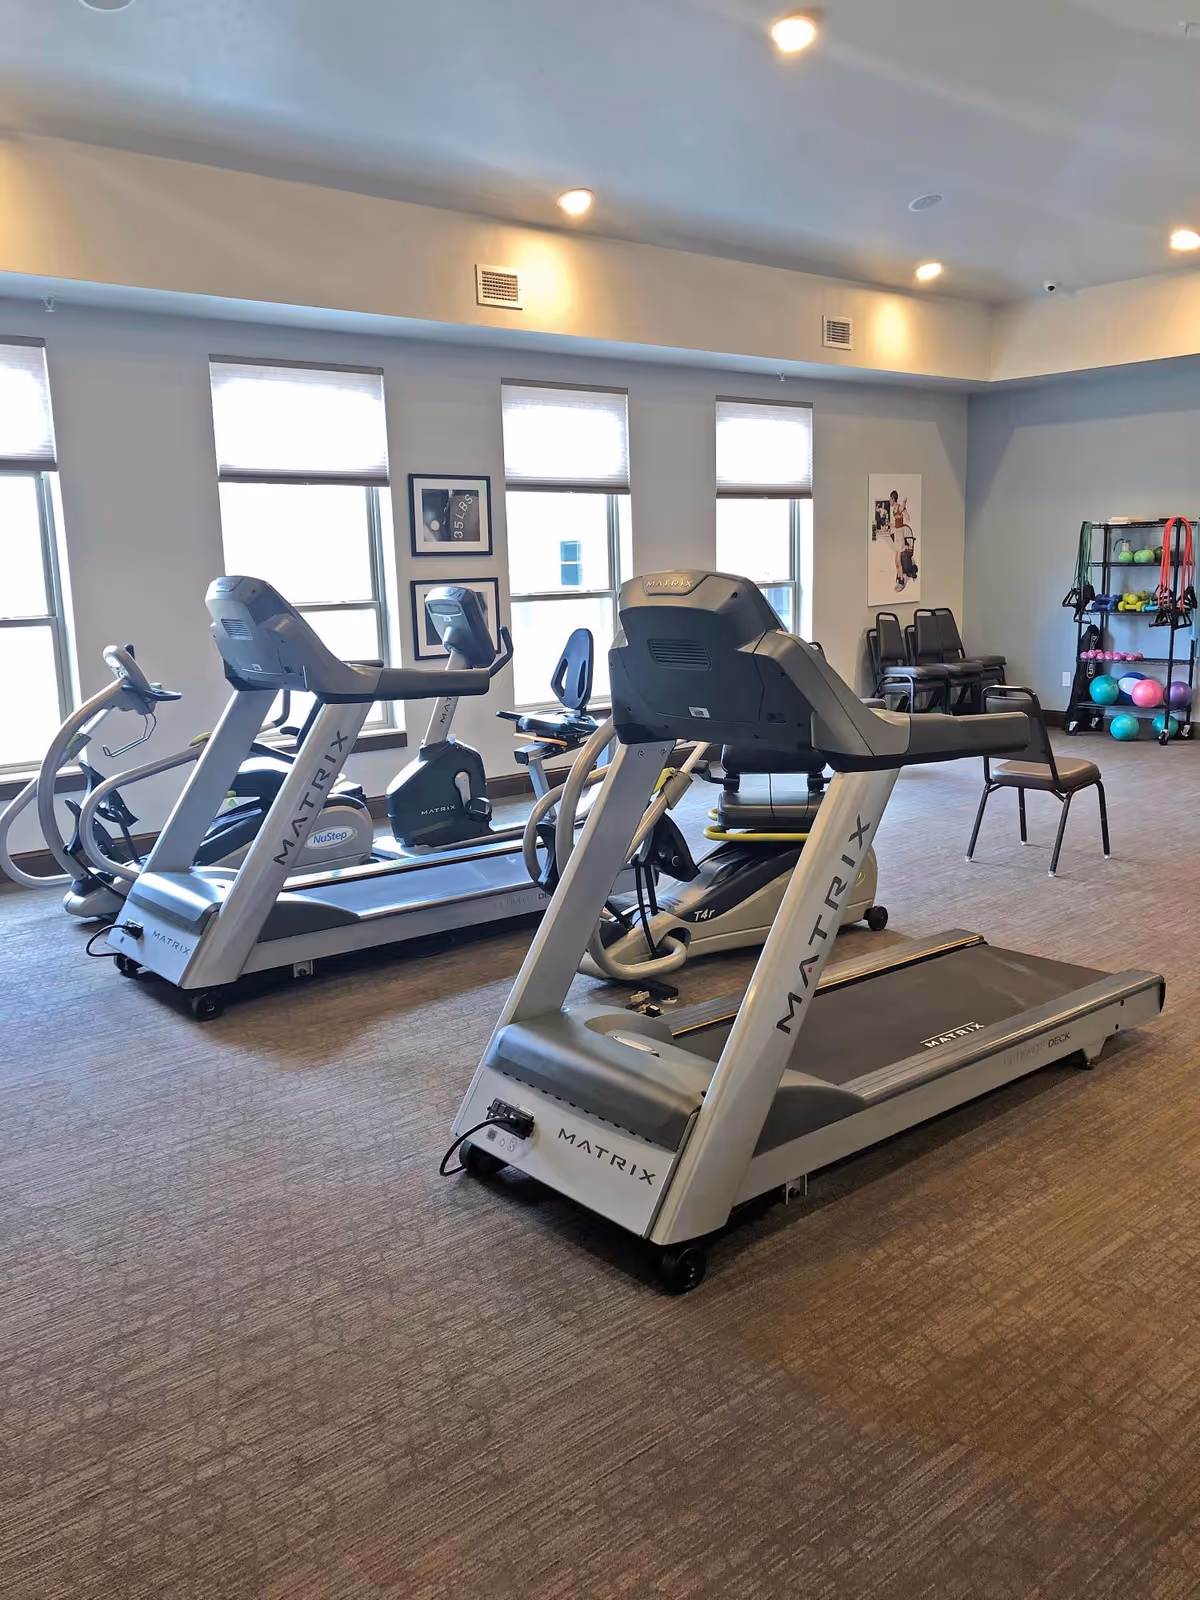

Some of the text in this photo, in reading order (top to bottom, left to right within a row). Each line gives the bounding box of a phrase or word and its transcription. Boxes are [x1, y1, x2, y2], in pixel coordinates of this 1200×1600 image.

[646, 579, 693, 588] MATRIX
[273, 730, 348, 865] MATRIX
[421, 804, 456, 815] MATRIX
[313, 830, 347, 845] NuStep
[694, 909, 715, 921] T4r
[776, 814, 871, 1034] MATRIX
[152, 930, 191, 955] MATRIX
[924, 1023, 985, 1048] MATRIX
[1048, 1032, 1071, 1048] DECK
[557, 1128, 656, 1185] MATRIX
